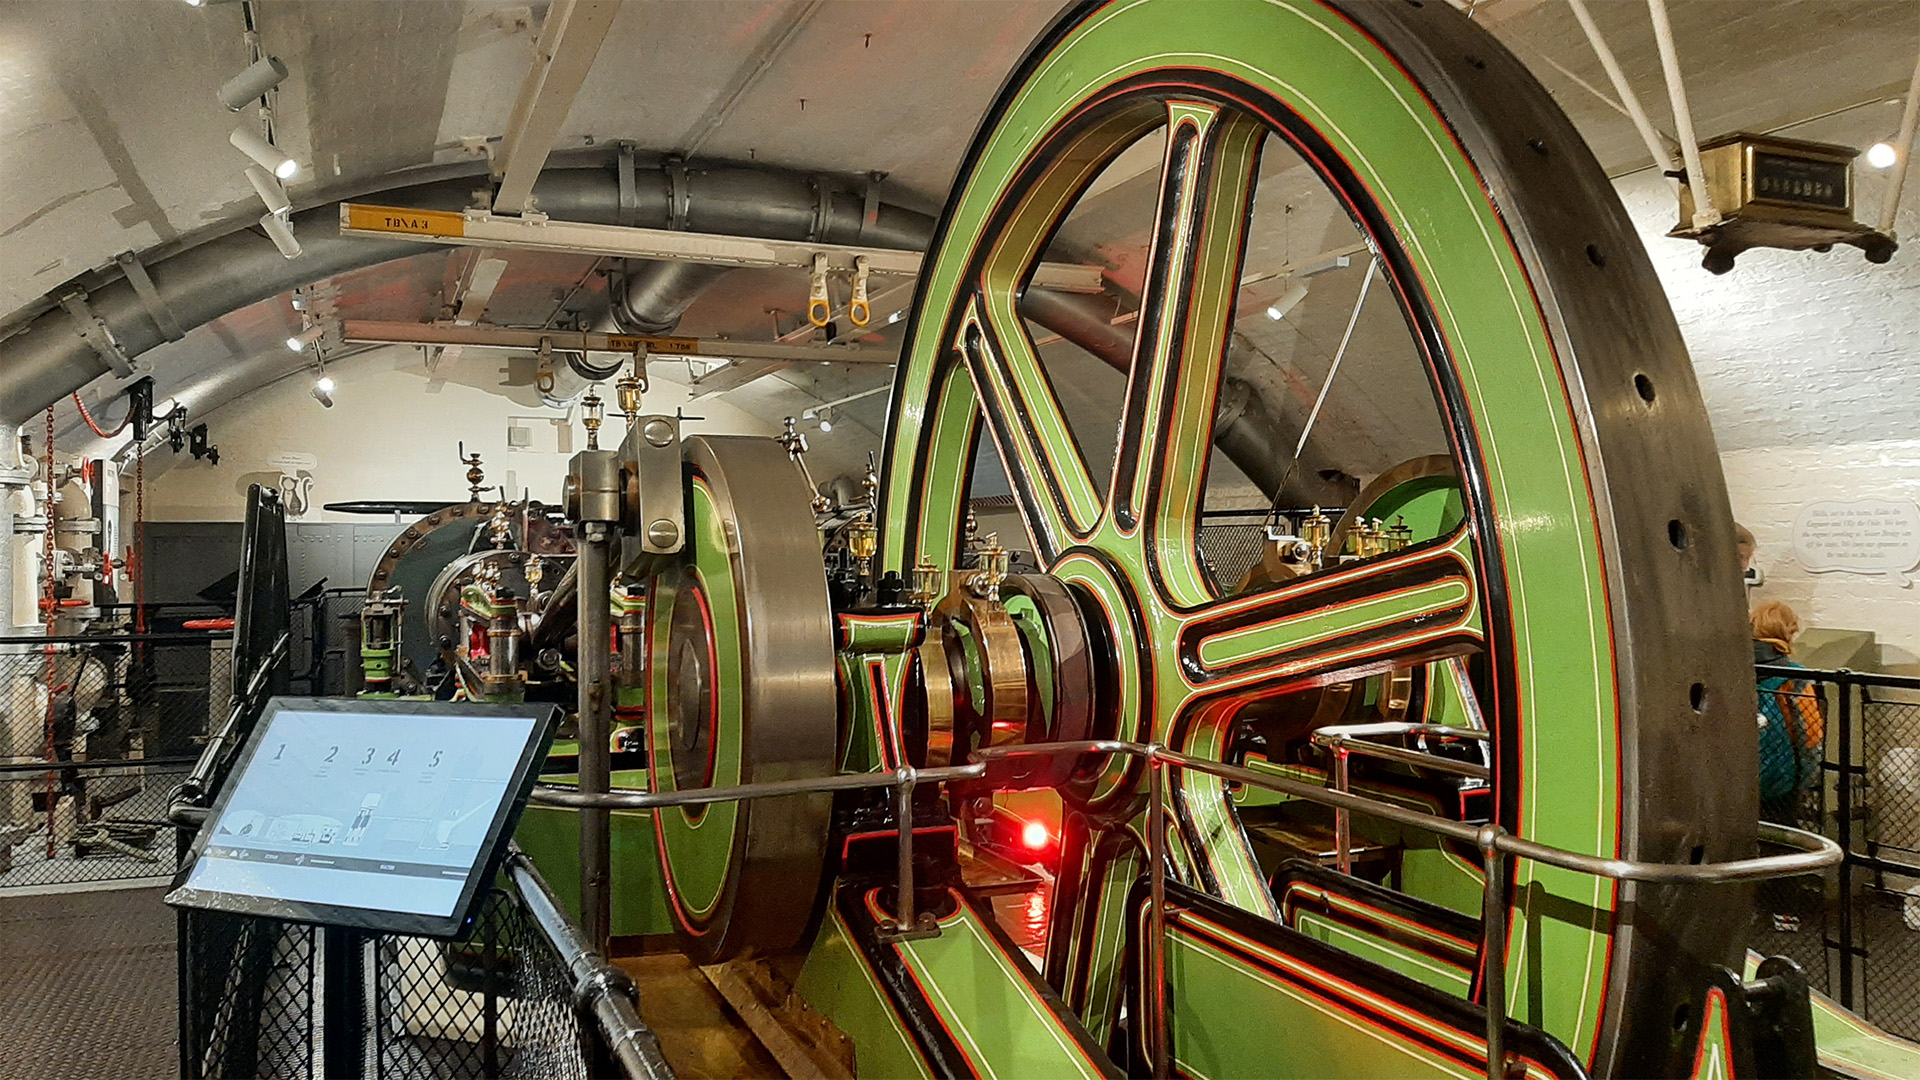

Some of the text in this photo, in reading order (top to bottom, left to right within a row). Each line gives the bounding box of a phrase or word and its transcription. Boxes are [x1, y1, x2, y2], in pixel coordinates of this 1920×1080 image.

[273, 744, 287, 760] 1
[324, 746, 339, 763] 2
[361, 747, 376, 765] 3
[386, 749, 401, 766] 4
[428, 750, 443, 768] 5
